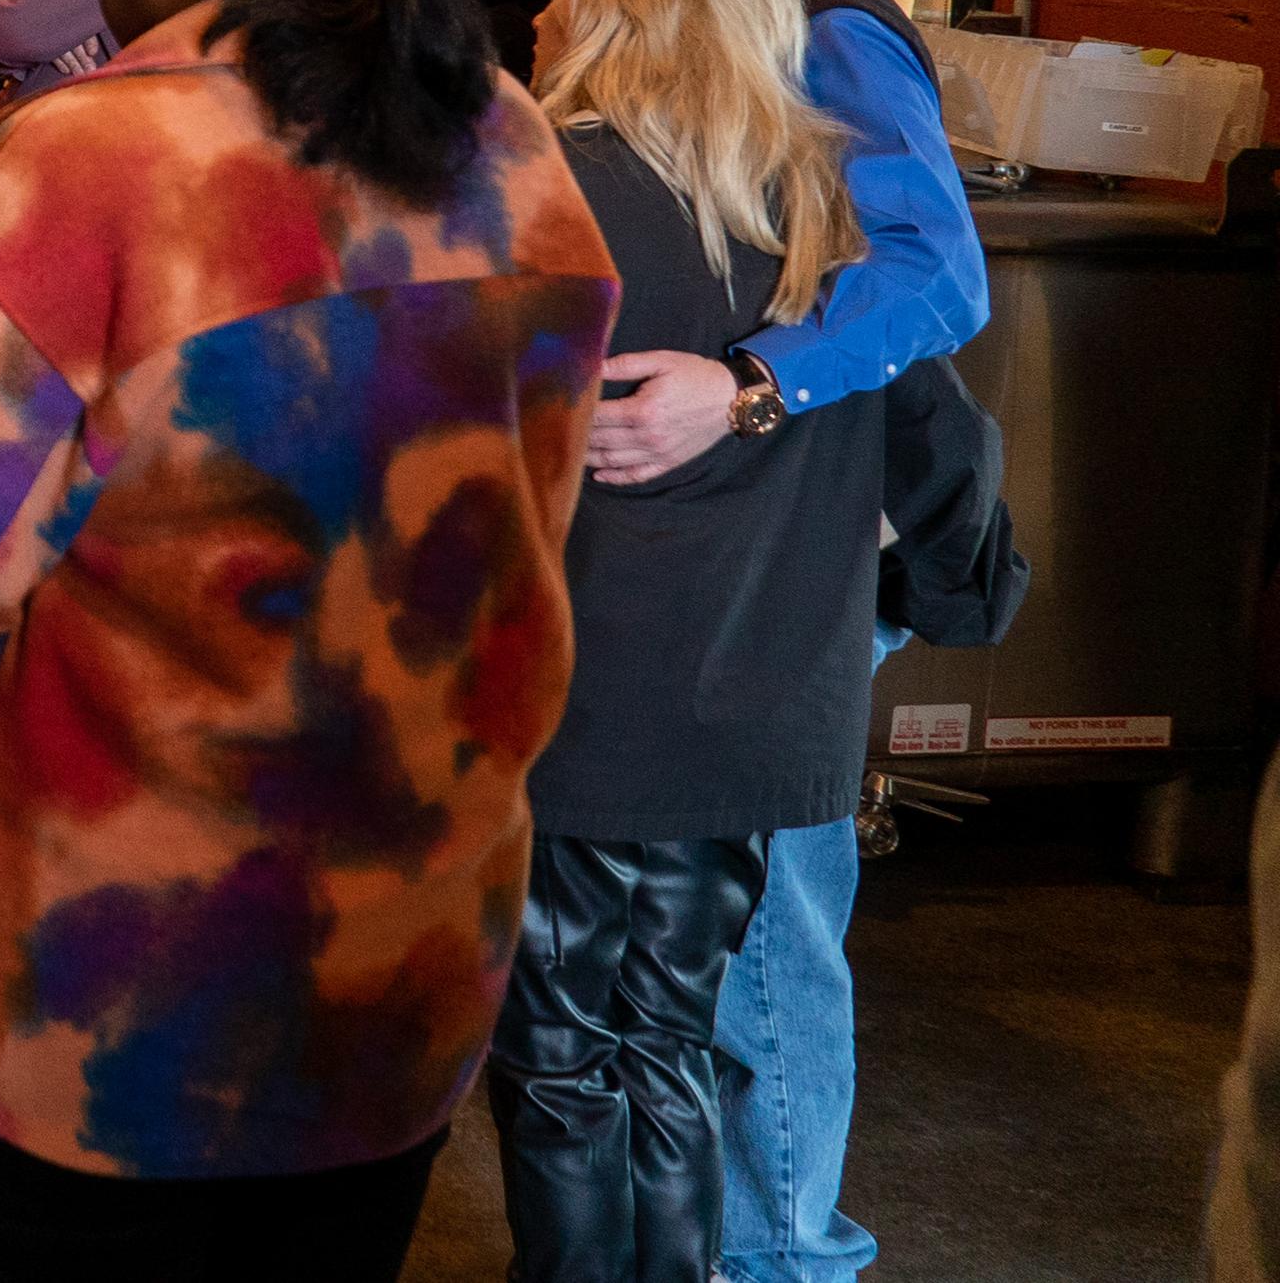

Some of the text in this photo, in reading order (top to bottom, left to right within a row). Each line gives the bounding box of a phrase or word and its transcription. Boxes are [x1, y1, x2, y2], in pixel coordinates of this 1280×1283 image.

[1029, 719, 1127, 730] NO FORKS THIS SIDE
[990, 737, 1003, 746] No
